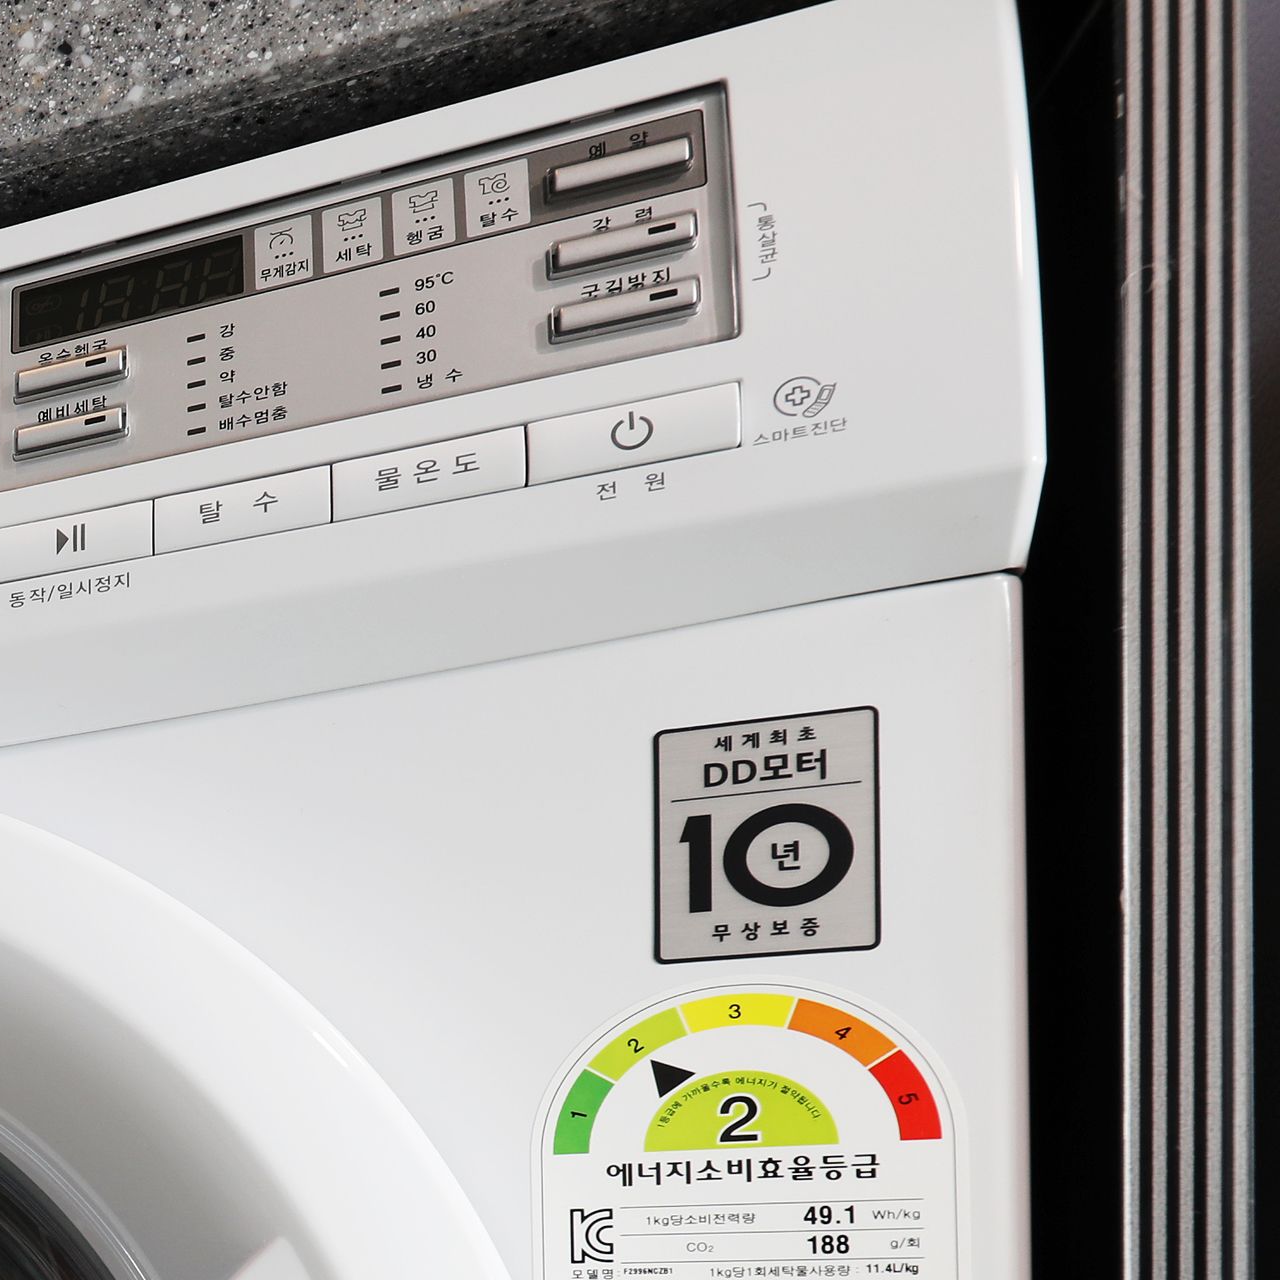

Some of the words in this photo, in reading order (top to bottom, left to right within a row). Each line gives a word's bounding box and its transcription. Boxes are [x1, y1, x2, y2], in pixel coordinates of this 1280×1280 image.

[480, 207, 520, 227] 탈수
[406, 225, 444, 246] 헹굼
[755, 214, 778, 265] 통살균
[336, 242, 372, 263] 세탁
[260, 259, 310, 283] 무게감지
[415, 300, 436, 315] 60
[219, 323, 235, 338] 강
[415, 324, 436, 339] 40
[219, 347, 236, 361] 중
[416, 349, 437, 364] 30
[219, 369, 236, 384] 약
[219, 381, 288, 408] 탈수안함
[219, 406, 288, 431] 배수멈춤
[752, 417, 848, 446] 스마트진단
[9, 571, 130, 609] 동작/일시정지
[714, 726, 816, 752] 세계최초
[703, 748, 827, 788] DD모터
[679, 803, 854, 913] 10
[771, 840, 801, 871] 년
[712, 917, 820, 942] 무상보증
[728, 1003, 741, 1019] 3
[835, 1025, 852, 1041] 4
[627, 1038, 644, 1054] 2
[898, 1092, 919, 1106] 5
[570, 1109, 587, 1120] 1
[719, 1095, 759, 1142] 2
[606, 1152, 880, 1187] 에너지소비효율등급
[803, 1205, 855, 1225] 49.1
[872, 1208, 921, 1221] Wh/kg
[807, 1234, 850, 1254] 188
[890, 1237, 920, 1249] g/회
[866, 1263, 919, 1275] 11.4L/kg
